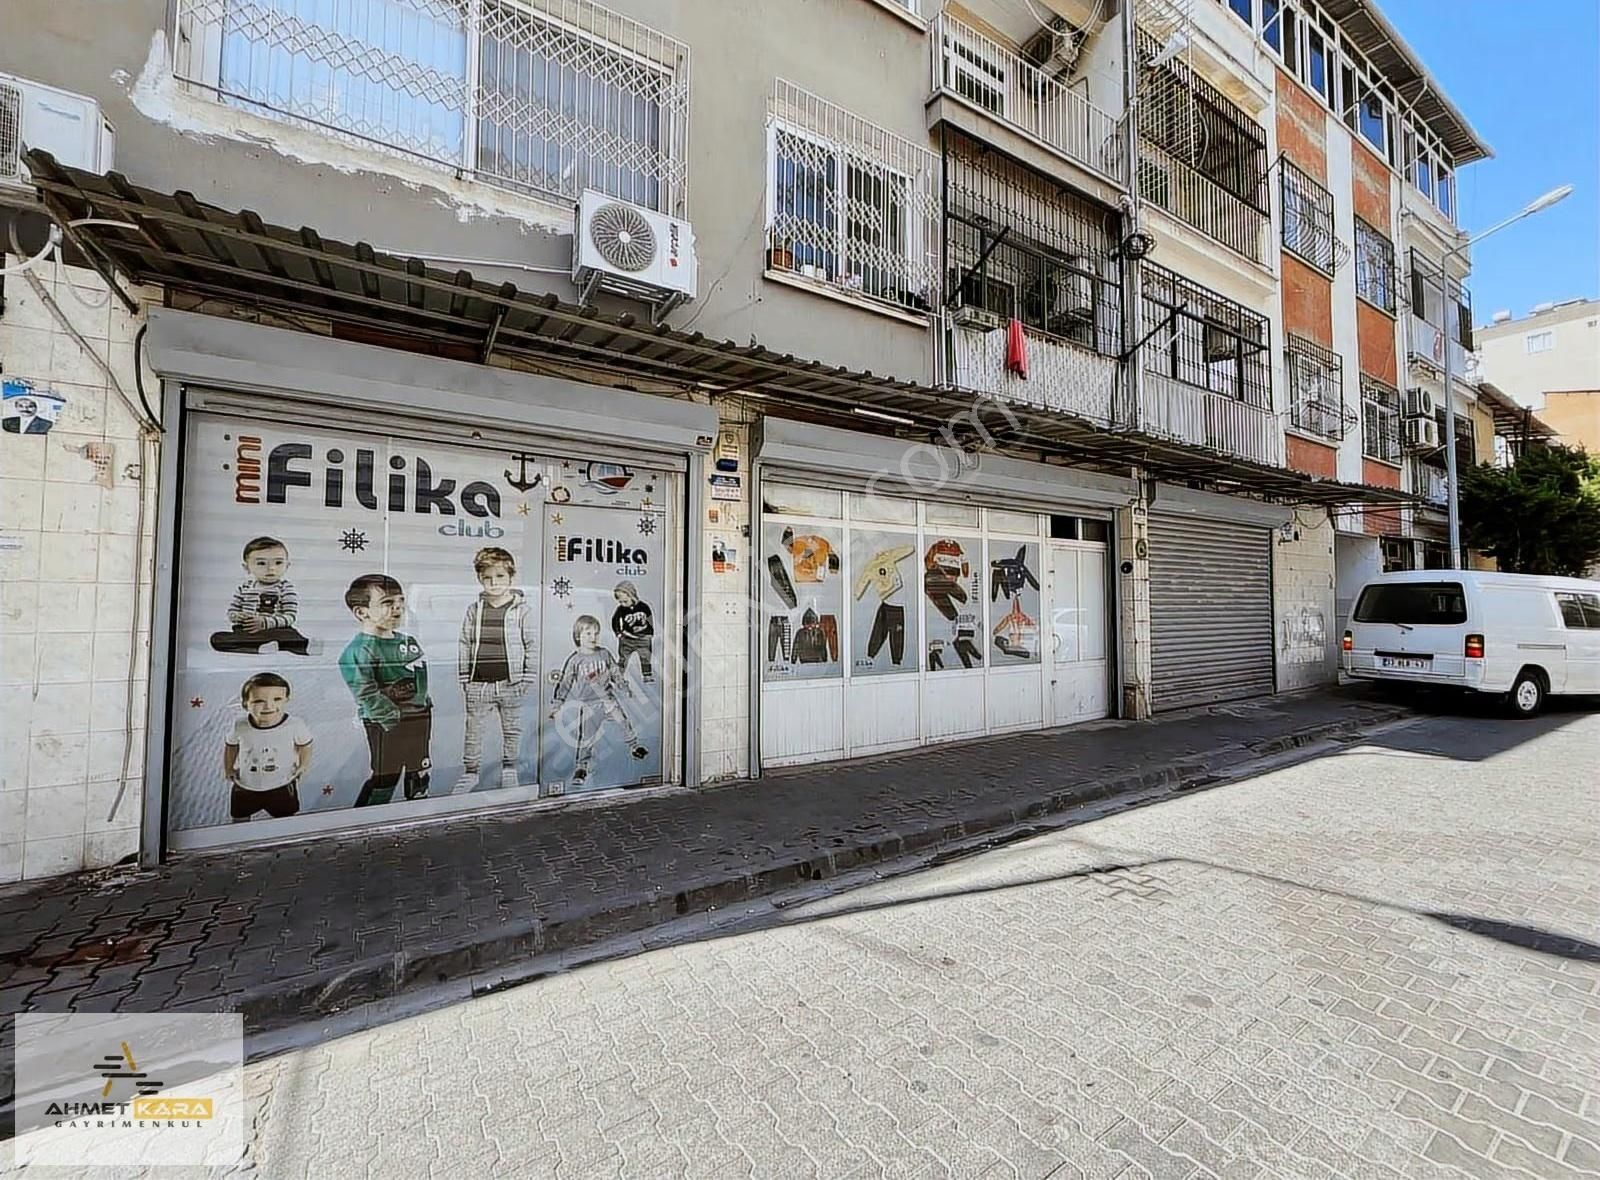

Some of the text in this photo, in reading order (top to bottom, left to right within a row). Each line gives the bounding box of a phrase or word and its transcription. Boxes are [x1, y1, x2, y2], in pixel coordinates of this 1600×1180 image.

[223, 434, 262, 504] mini
[266, 442, 502, 519] Filika
[438, 518, 505, 539] club
[567, 537, 648, 564] Filika
[616, 565, 647, 576] club
